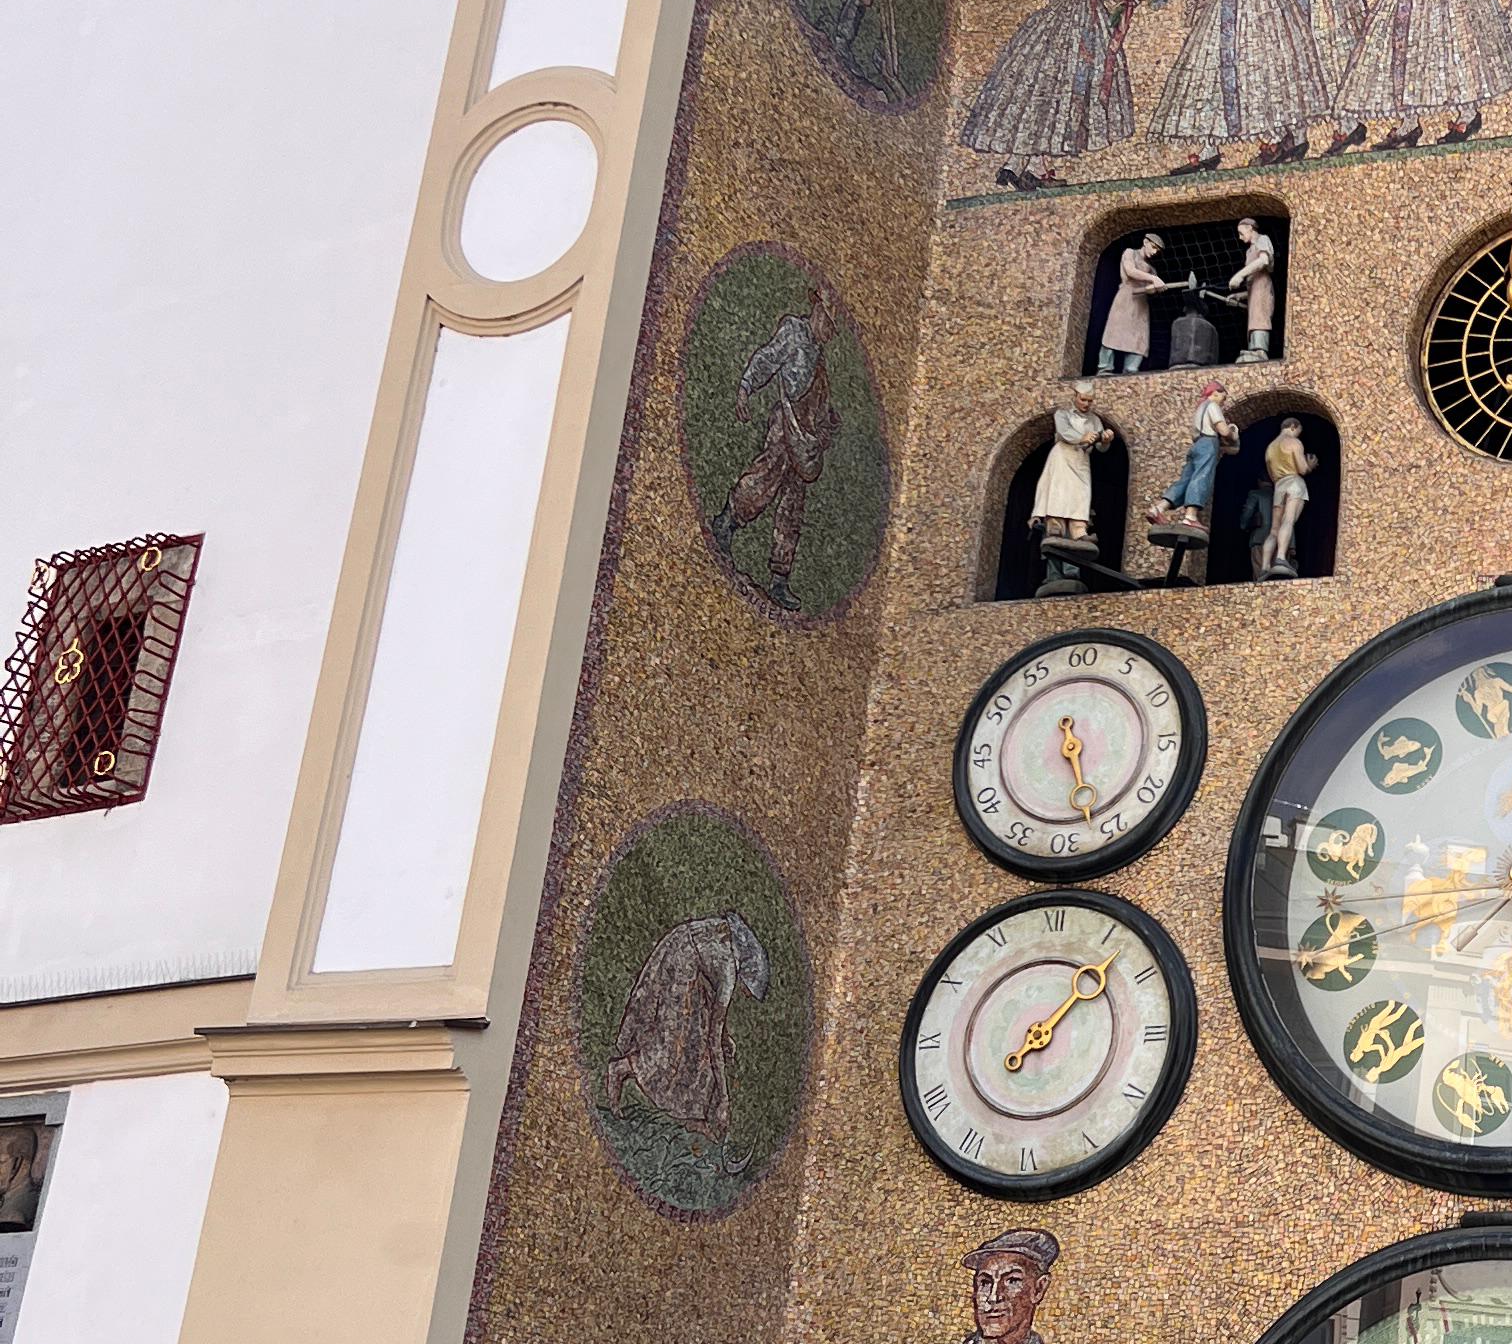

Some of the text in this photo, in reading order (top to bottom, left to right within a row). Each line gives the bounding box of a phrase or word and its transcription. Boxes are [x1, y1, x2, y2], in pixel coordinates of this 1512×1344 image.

[1068, 647, 1098, 668] 60
[1118, 657, 1138, 675] 5
[1023, 660, 1050, 687] 55
[1146, 683, 1170, 708] 10
[986, 694, 1013, 725] 50
[1157, 732, 1176, 752] 15
[973, 743, 992, 768] 45
[977, 787, 1001, 815] 40
[1137, 775, 1164, 804] 20
[1005, 822, 1035, 846] 35
[1100, 814, 1128, 842] 25
[1050, 832, 1080, 854] 30
[1043, 910, 1065, 932] XII
[986, 927, 1007, 947] XI
[1101, 924, 1116, 945] I
[941, 973, 962, 993] X
[1134, 966, 1157, 984] II
[919, 1032, 941, 1050] IX
[1144, 1025, 1167, 1043] III
[923, 1084, 951, 1121] VIII
[1122, 1083, 1146, 1107] IV
[958, 1128, 984, 1160] VII
[1082, 1131, 1098, 1152] V
[1020, 1147, 1038, 1171] VI
